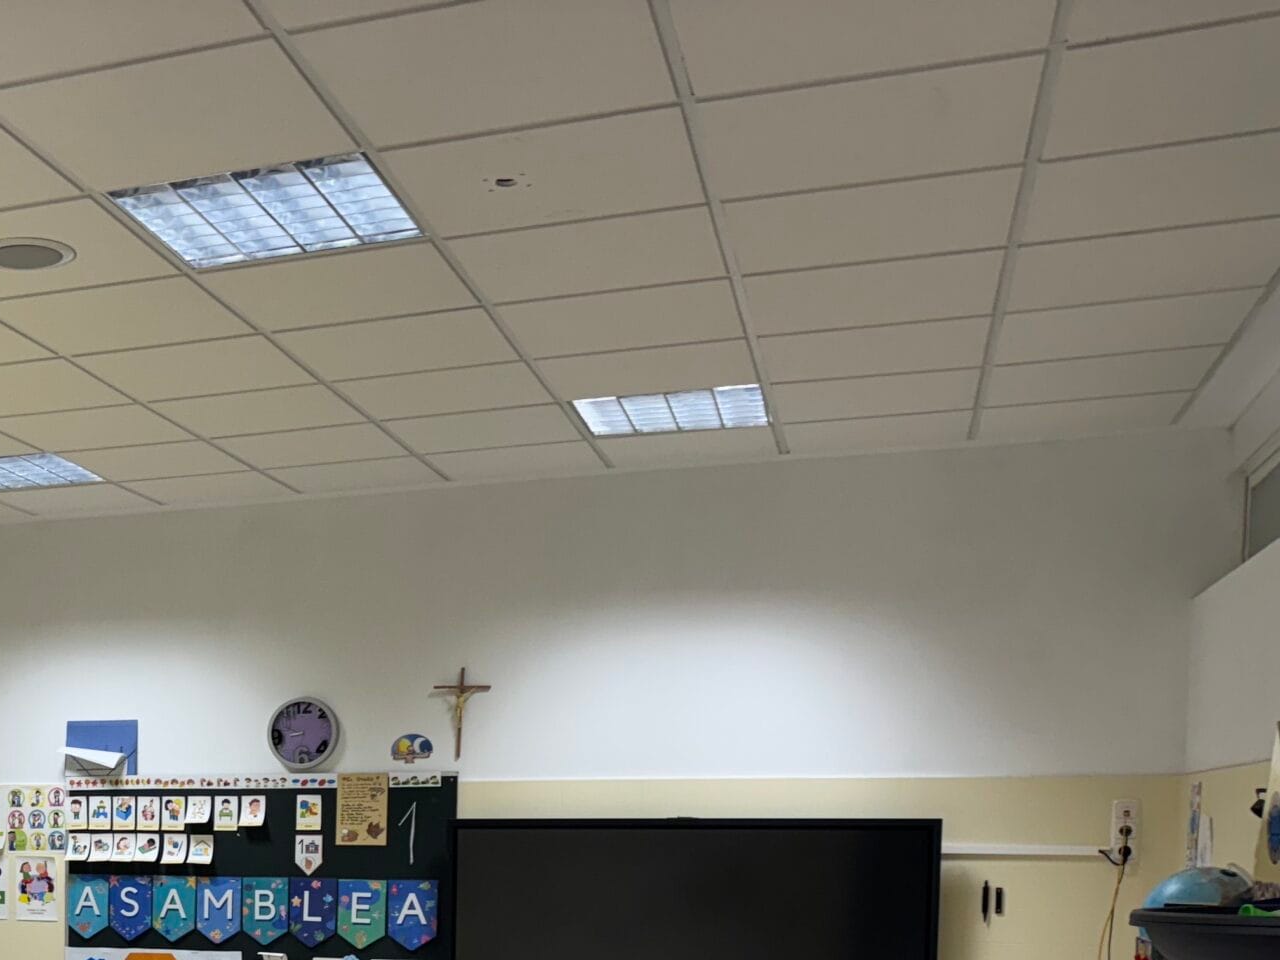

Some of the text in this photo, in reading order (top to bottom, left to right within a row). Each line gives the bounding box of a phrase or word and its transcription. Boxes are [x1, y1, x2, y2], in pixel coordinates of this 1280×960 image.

[296, 702, 313, 715] 12
[317, 707, 328, 720] 2
[398, 801, 417, 865] 1
[297, 838, 305, 855] 1
[74, 886, 428, 926] ASAMBLEA
